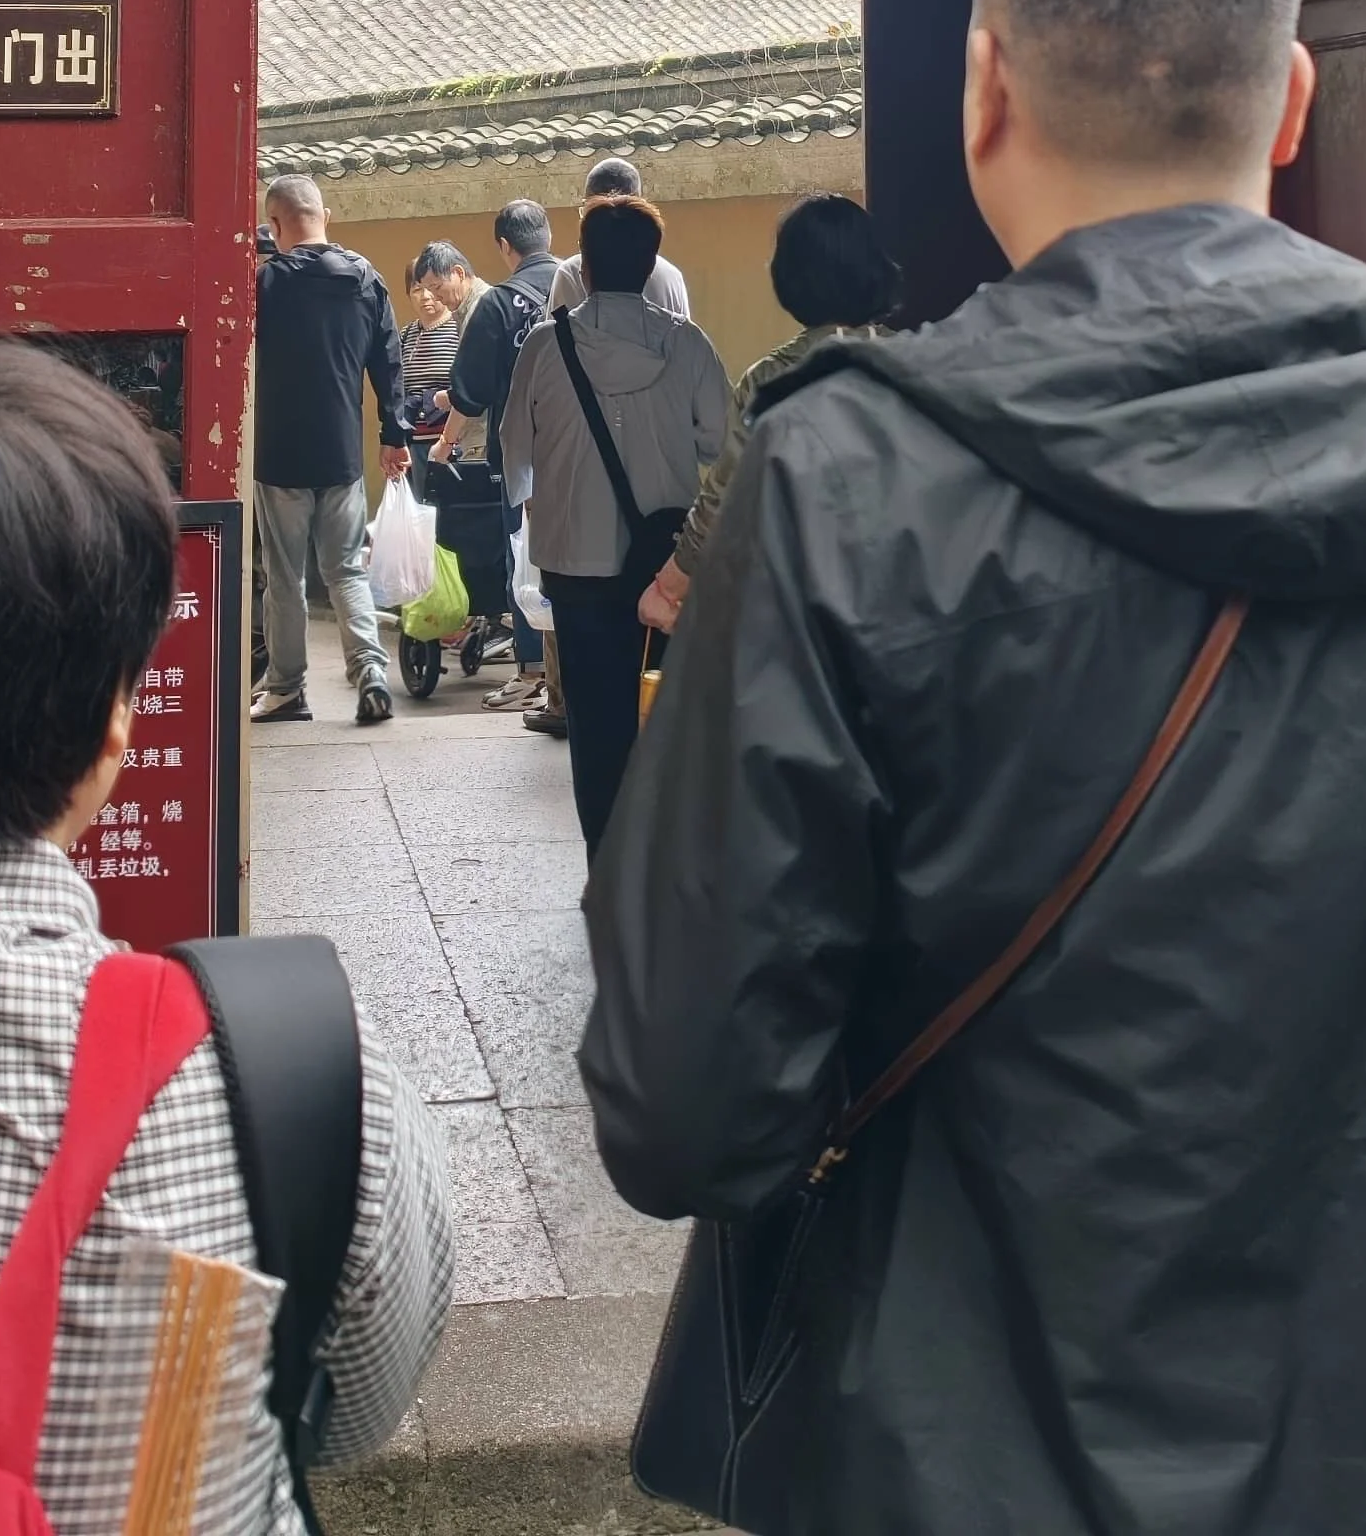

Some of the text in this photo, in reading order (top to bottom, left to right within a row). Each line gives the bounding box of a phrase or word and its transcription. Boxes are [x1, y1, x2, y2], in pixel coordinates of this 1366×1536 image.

[137, 667, 184, 688] 自带
[120, 747, 183, 768] 及贵重
[90, 799, 183, 826] 金箔，烧
[67, 856, 170, 880] 乱丢垃圾，
